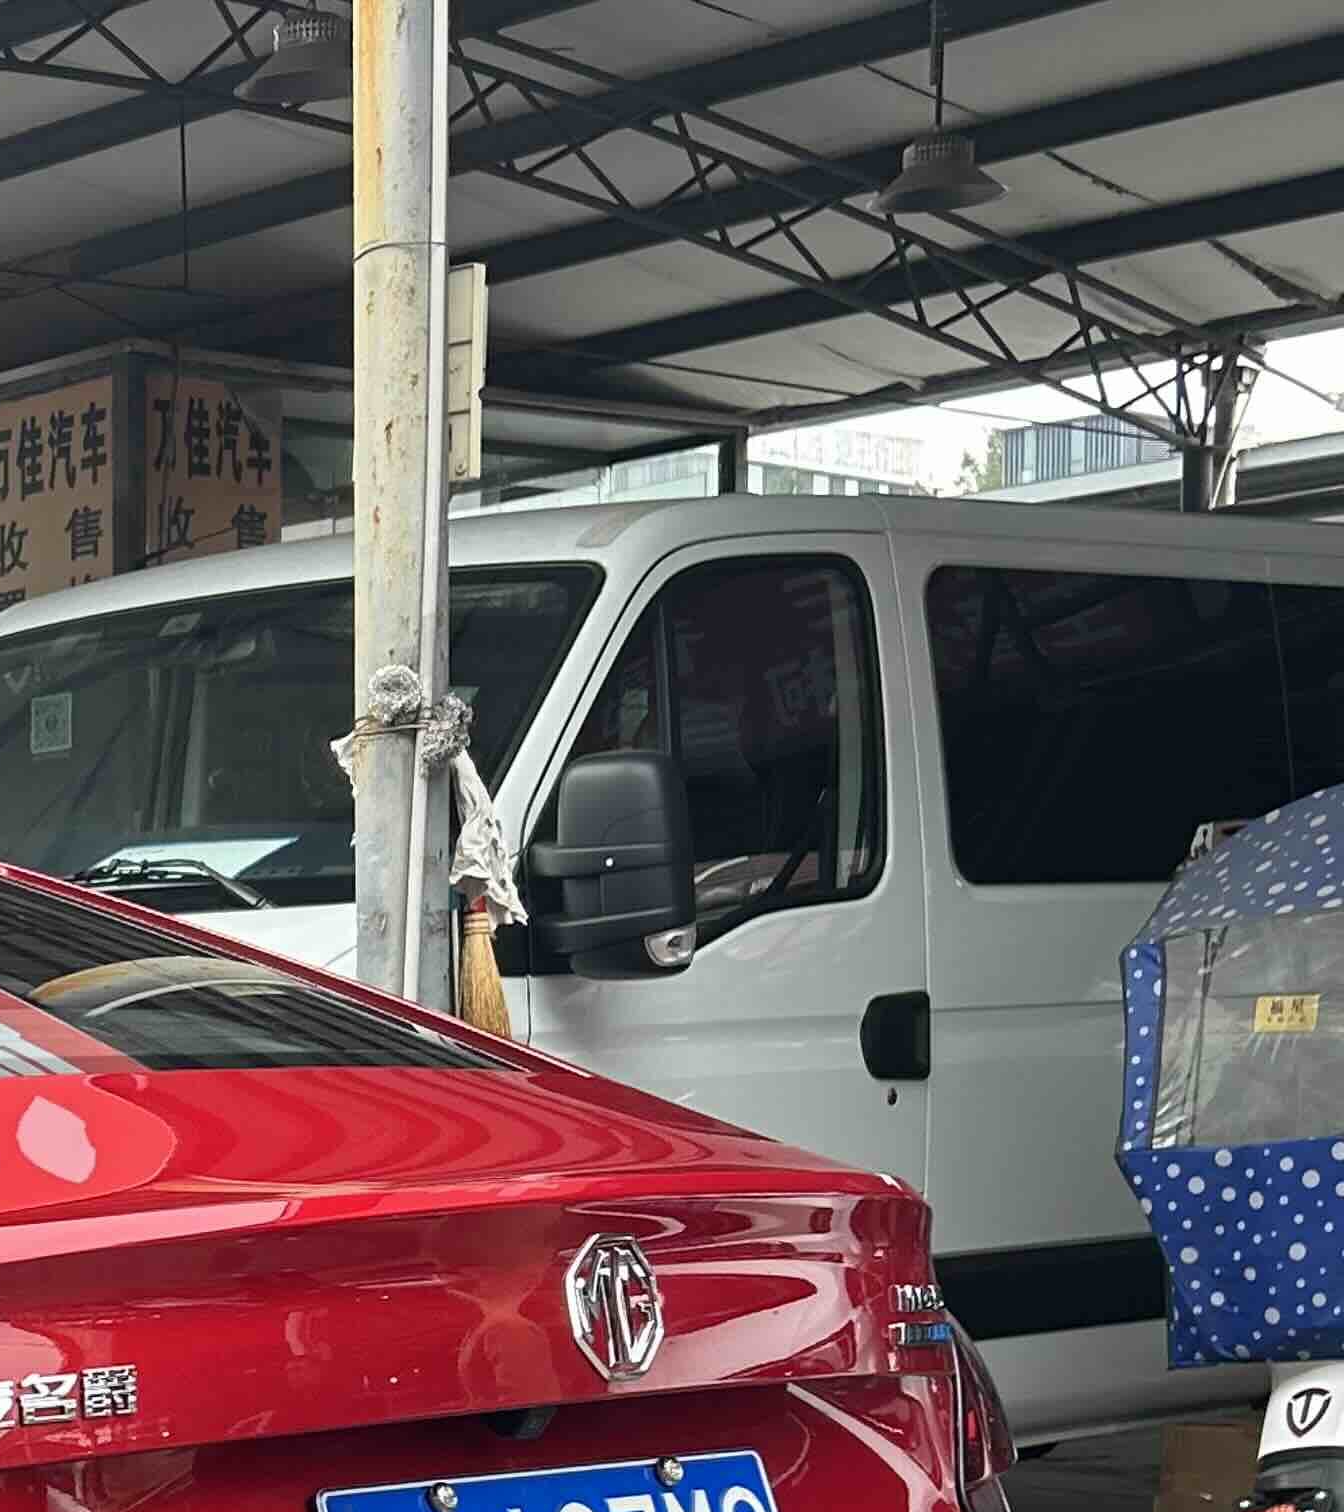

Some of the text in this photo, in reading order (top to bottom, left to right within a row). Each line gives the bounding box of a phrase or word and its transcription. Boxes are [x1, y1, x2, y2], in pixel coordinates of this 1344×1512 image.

[152, 396, 273, 486] 万佳汽车
[64, 505, 104, 561] 售
[158, 496, 268, 550] 收 售
[565, 1246, 658, 1368] MG
